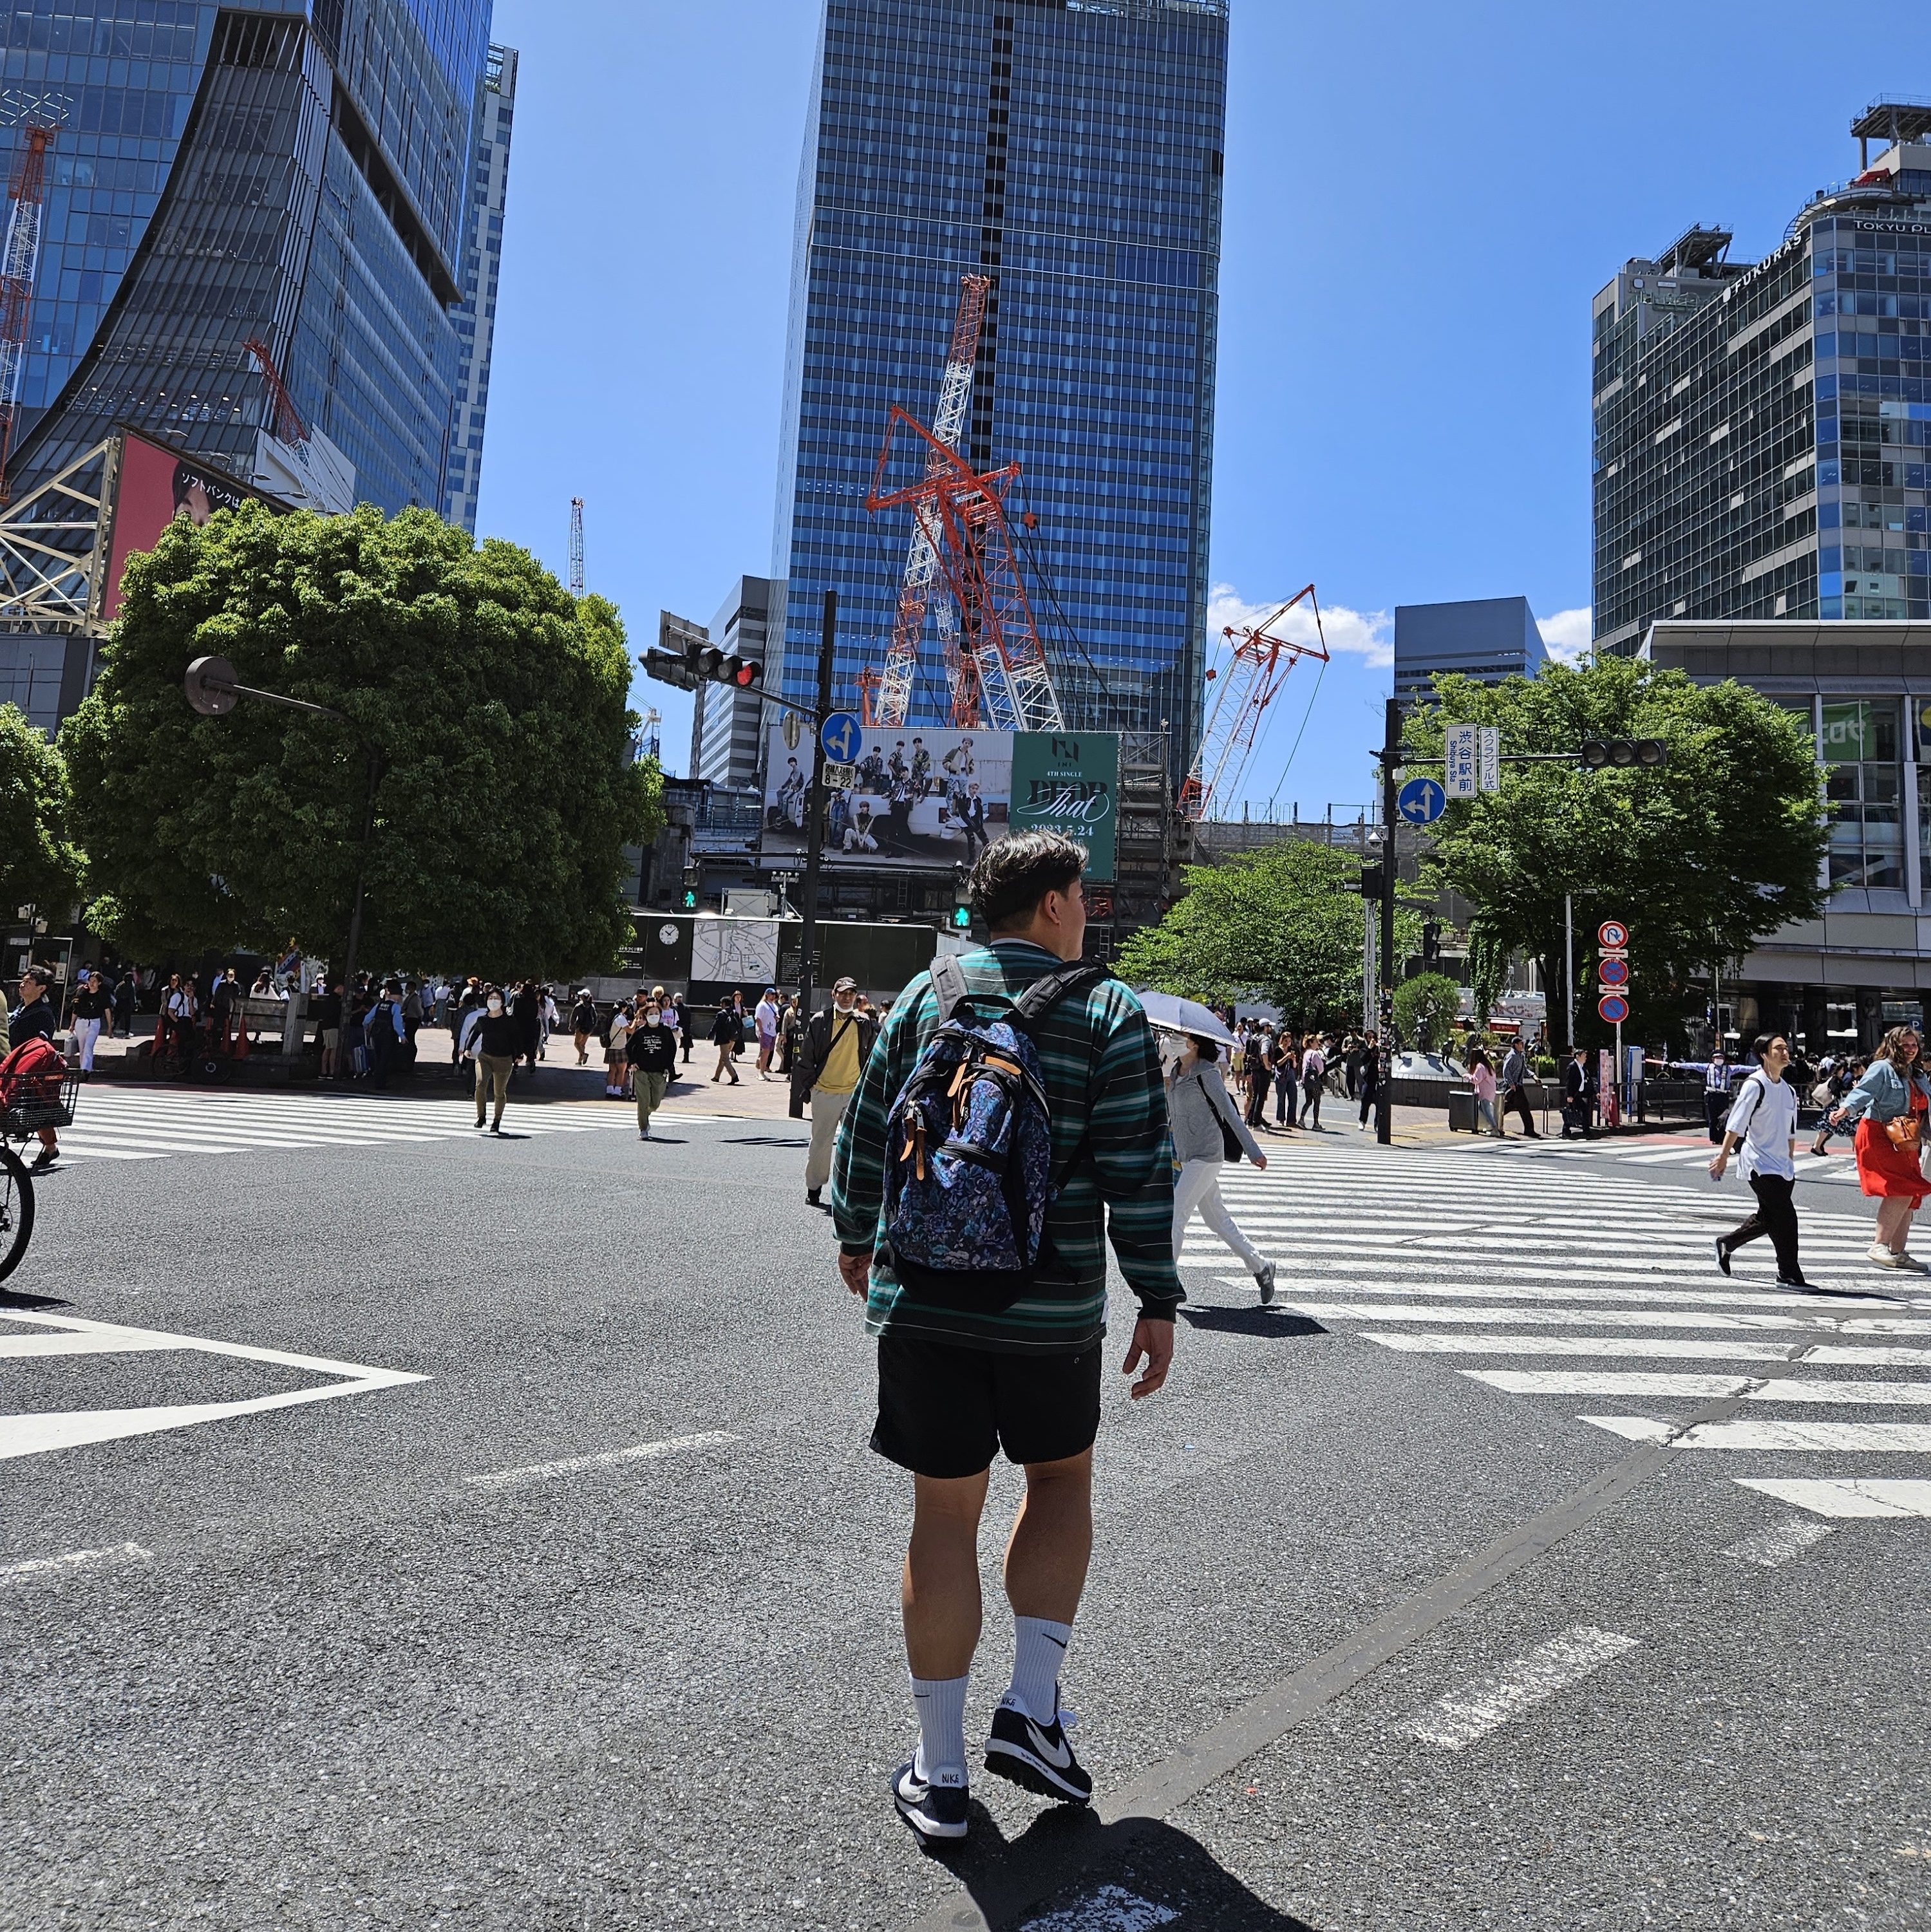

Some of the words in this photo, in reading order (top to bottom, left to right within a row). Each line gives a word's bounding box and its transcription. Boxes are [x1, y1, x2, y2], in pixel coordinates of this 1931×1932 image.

[1854, 220, 1905, 232] TOKYU
[1734, 230, 1802, 293] FUKURAS
[182, 473, 240, 509] ソフトバンクは
[1449, 740, 1457, 768] Shibuya
[1458, 730, 1473, 792] 渋谷駅前
[1484, 731, 1495, 789] スクランブル式
[1017, 783, 1110, 823] That
[1028, 780, 1108, 807] DROP
[1031, 823, 1093, 836] 20235.24
[1912, 1020, 1919, 1029] P
